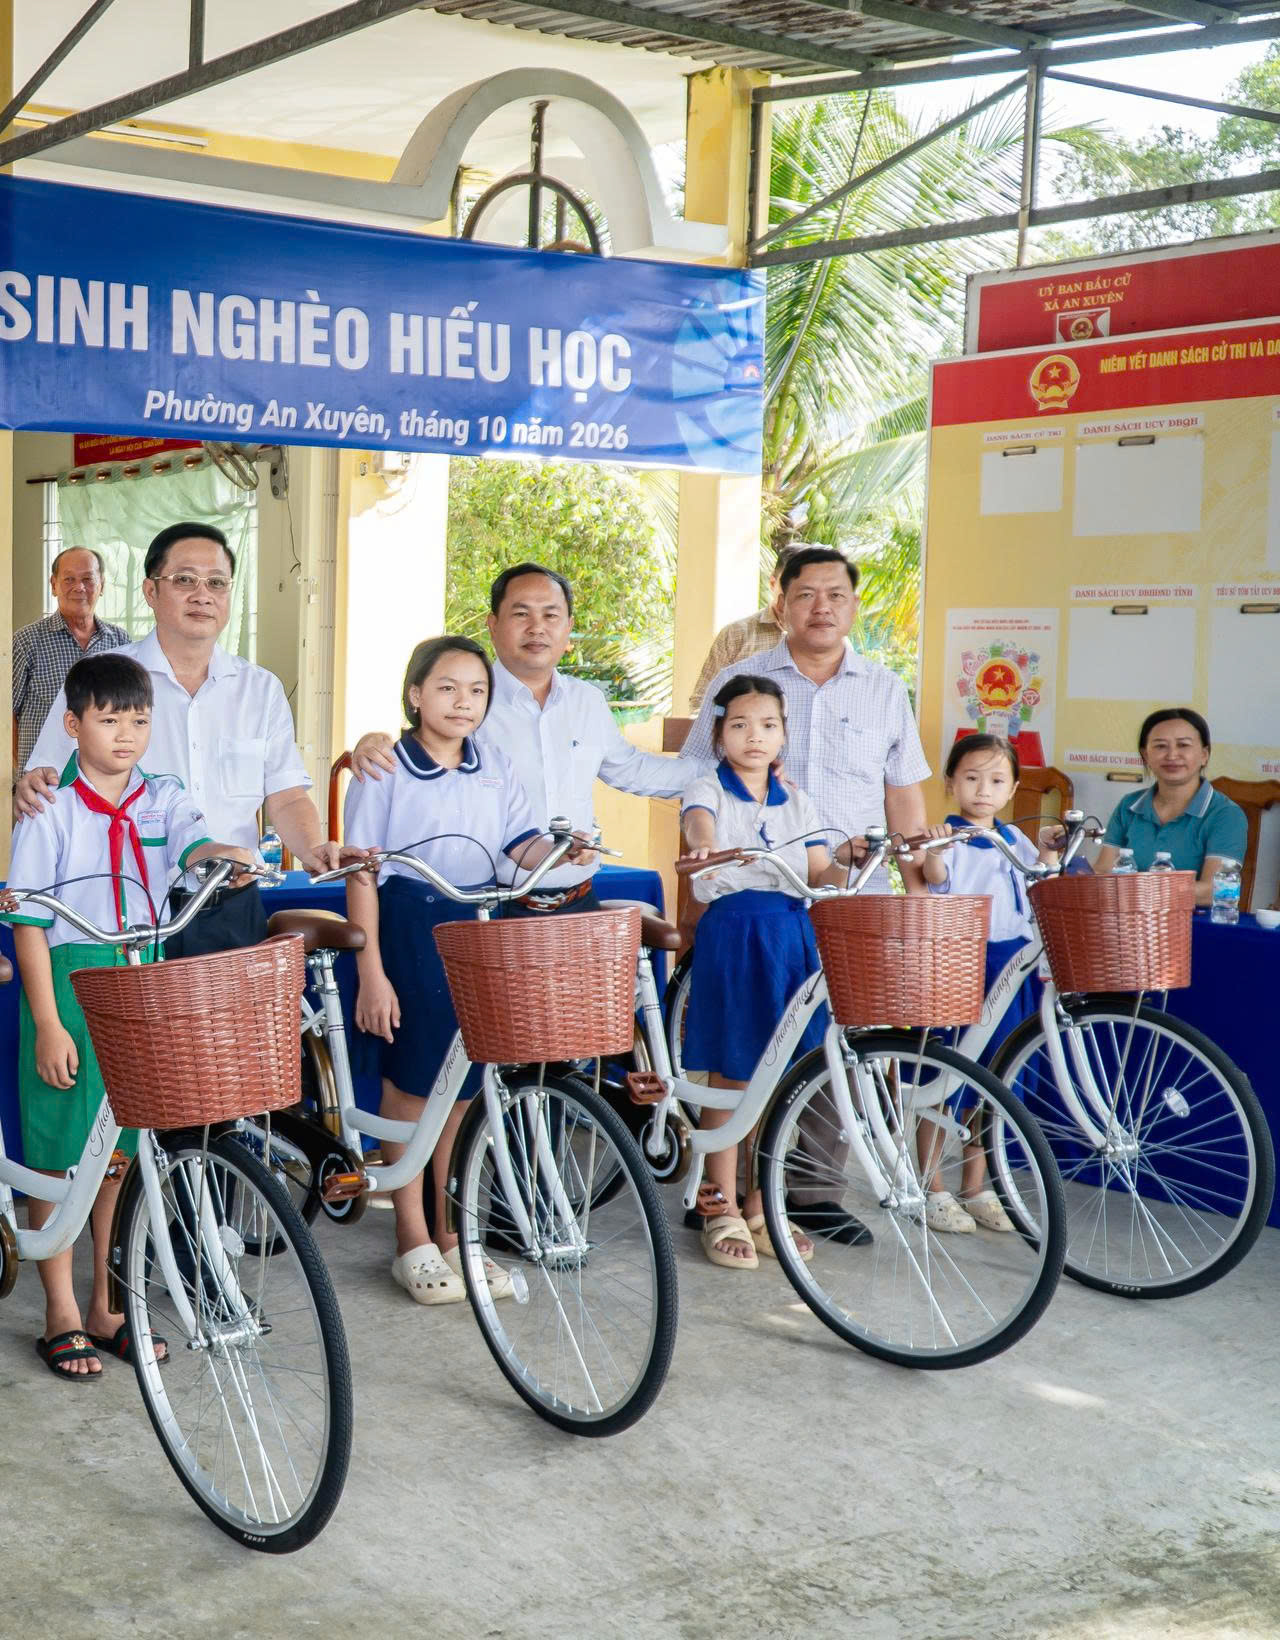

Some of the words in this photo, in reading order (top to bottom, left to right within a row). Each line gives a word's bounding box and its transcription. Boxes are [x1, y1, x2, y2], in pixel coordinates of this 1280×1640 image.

[1059, 282, 1082, 295] BAN
[1063, 297, 1080, 309] AN
[1083, 291, 1124, 307] XUYÊN
[172, 289, 370, 372] NGHÈO
[388, 300, 511, 385] HIẾU
[528, 328, 632, 403] HỌC
[1149, 350, 1178, 368] DANH
[1180, 346, 1209, 364] SÁCH
[1229, 343, 1247, 360] TRI
[1249, 338, 1264, 357] VÀ
[144, 389, 254, 432] Phường
[260, 400, 297, 428] An
[304, 402, 391, 441] Xuyên,
[400, 408, 469, 446] tháng
[478, 415, 507, 443] 10
[512, 417, 564, 446] năm
[570, 421, 630, 450] 2026
